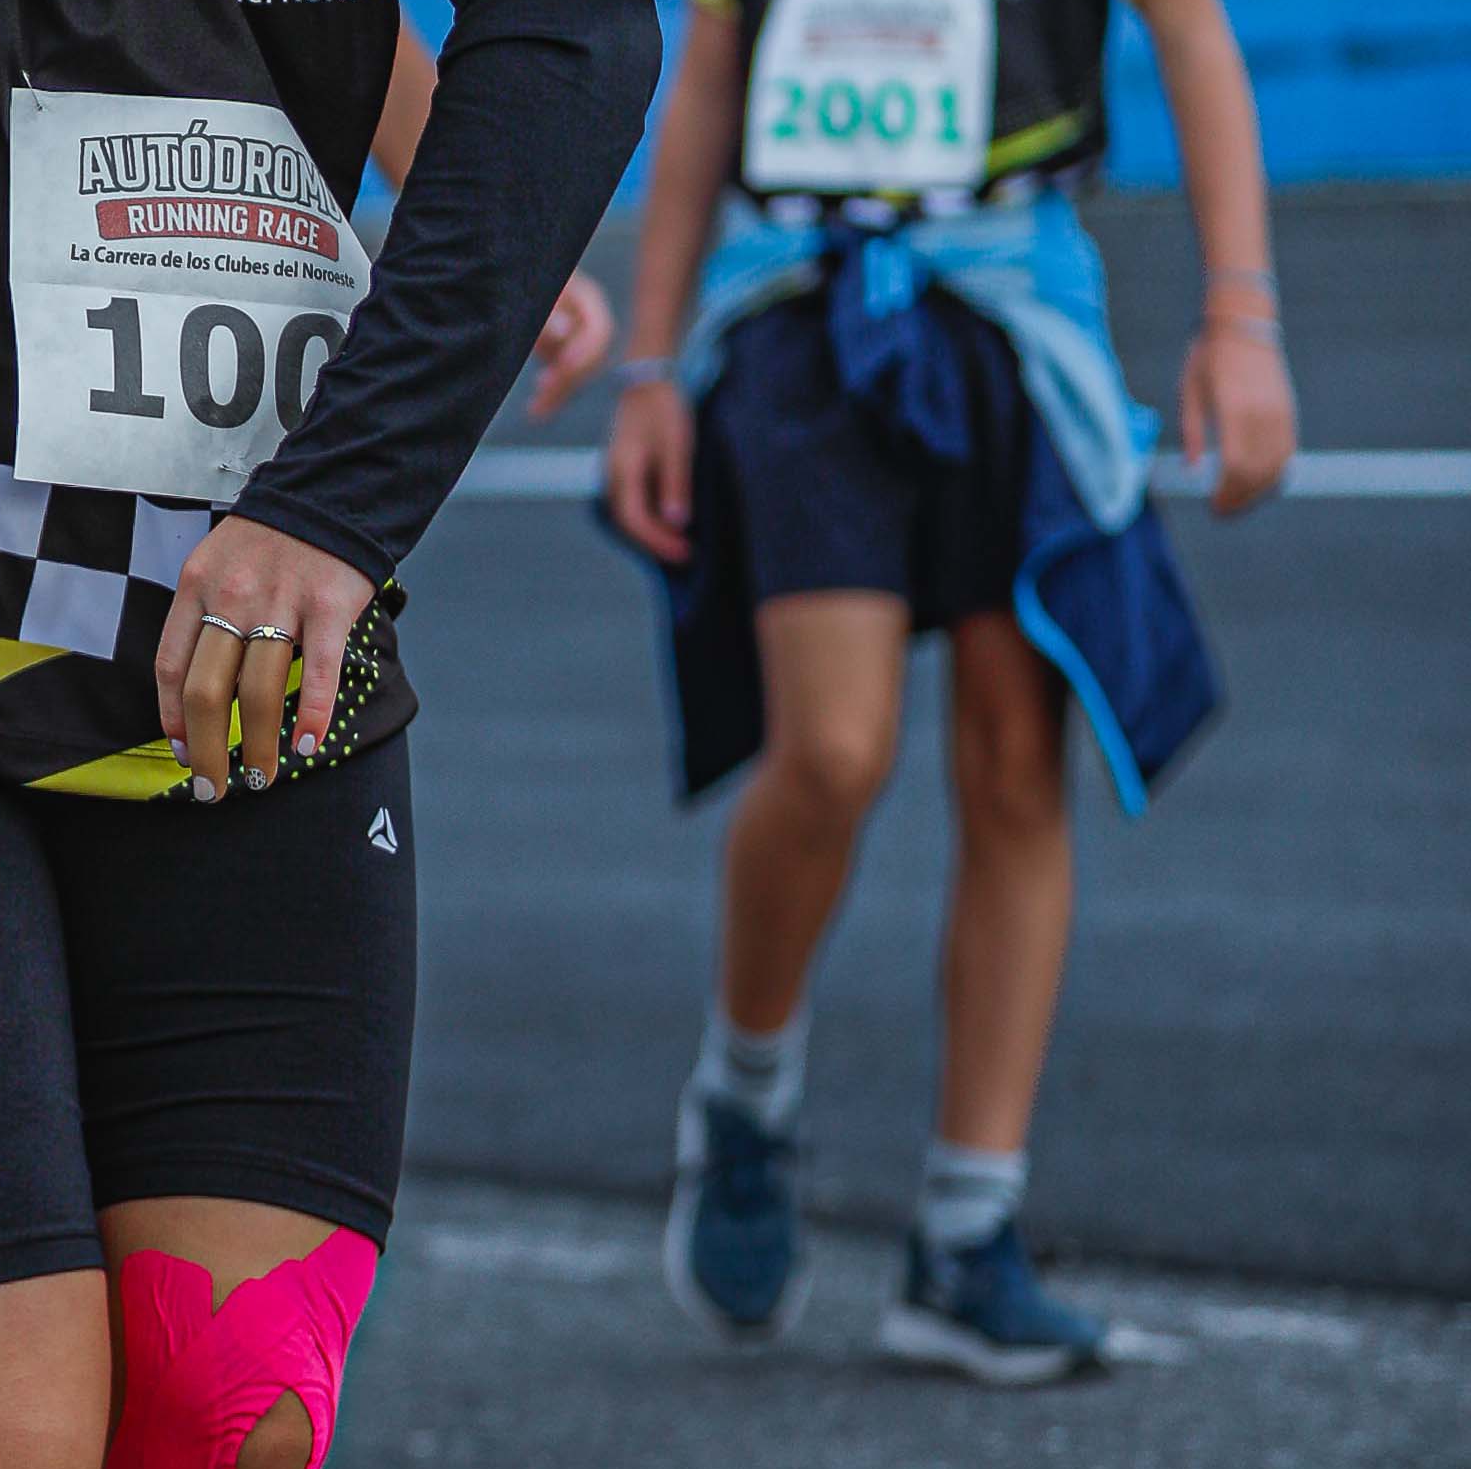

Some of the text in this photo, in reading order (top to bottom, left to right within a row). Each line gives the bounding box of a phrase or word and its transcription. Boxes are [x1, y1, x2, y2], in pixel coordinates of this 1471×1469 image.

[769, 77, 962, 145] 2001
[127, 202, 321, 250] RUNNING RACE
[70, 243, 356, 289] La Carrera de los Clubes del Noroeste
